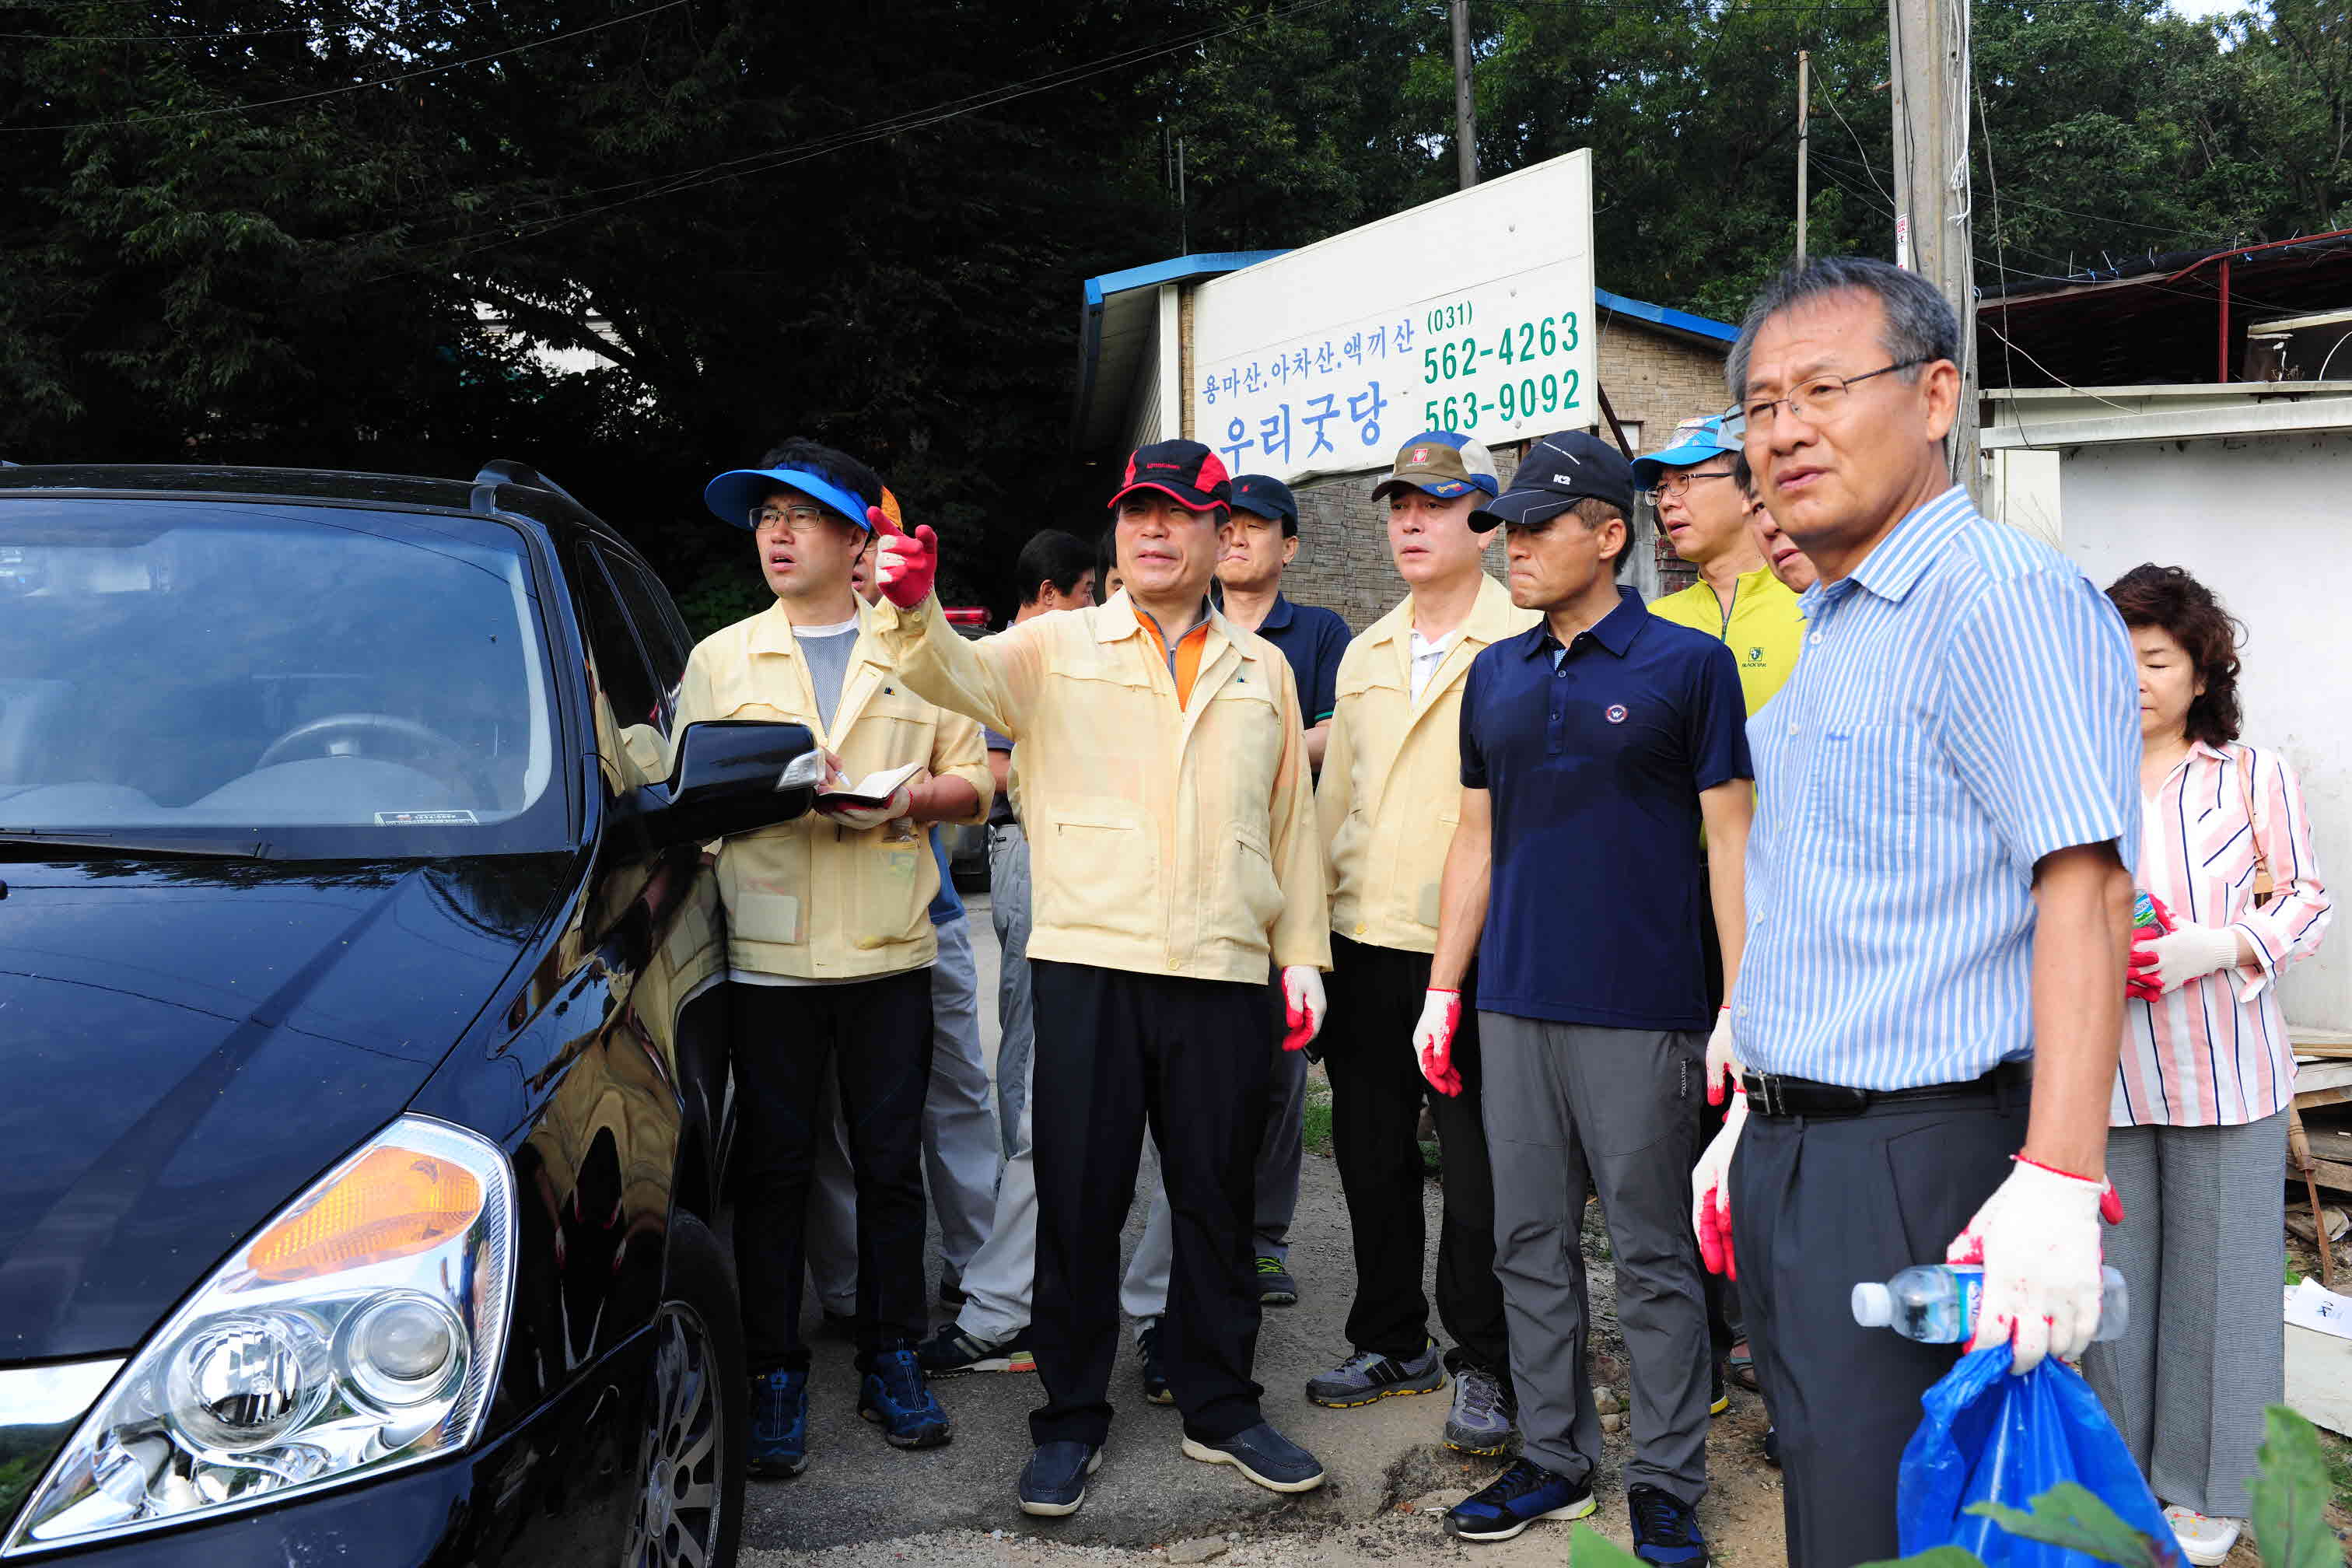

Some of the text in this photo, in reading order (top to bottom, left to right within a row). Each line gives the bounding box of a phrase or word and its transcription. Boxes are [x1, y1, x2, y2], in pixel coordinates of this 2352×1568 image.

[1424, 311, 1580, 385] 562-4263
[1428, 301, 1472, 335] (031)
[1218, 380, 1389, 474] 우리굿당
[1426, 369, 1580, 433] 563-9092
[1553, 474, 1571, 485] K2
